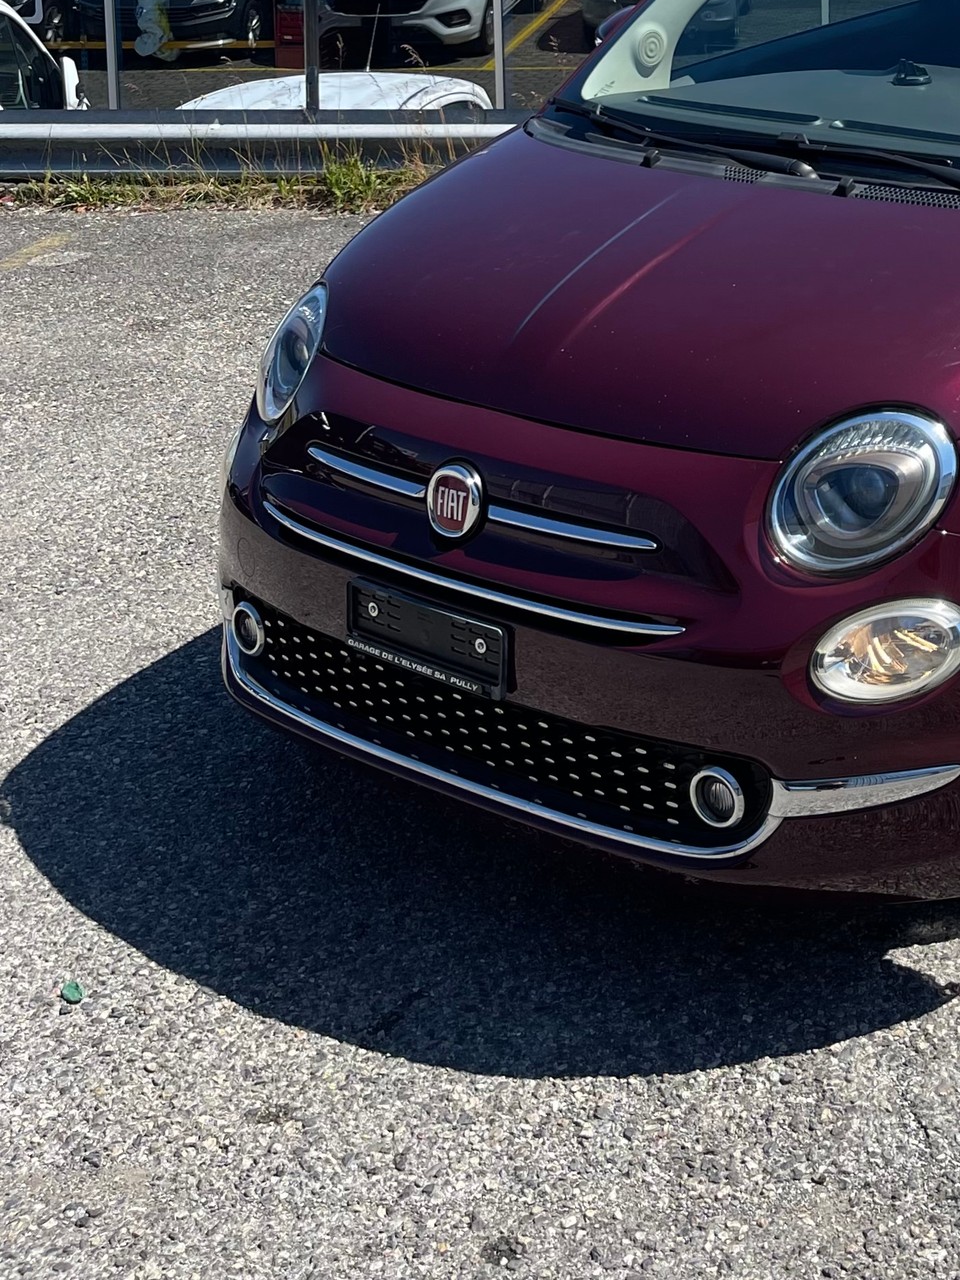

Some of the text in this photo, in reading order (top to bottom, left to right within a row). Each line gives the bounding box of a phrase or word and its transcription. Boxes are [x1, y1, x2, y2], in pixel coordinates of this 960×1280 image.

[437, 485, 467, 522] FIAT
[347, 638, 381, 657] GARAGE
[381, 650, 394, 662] DE
[433, 670, 447, 682] SA
[449, 676, 478, 692] PULLY
